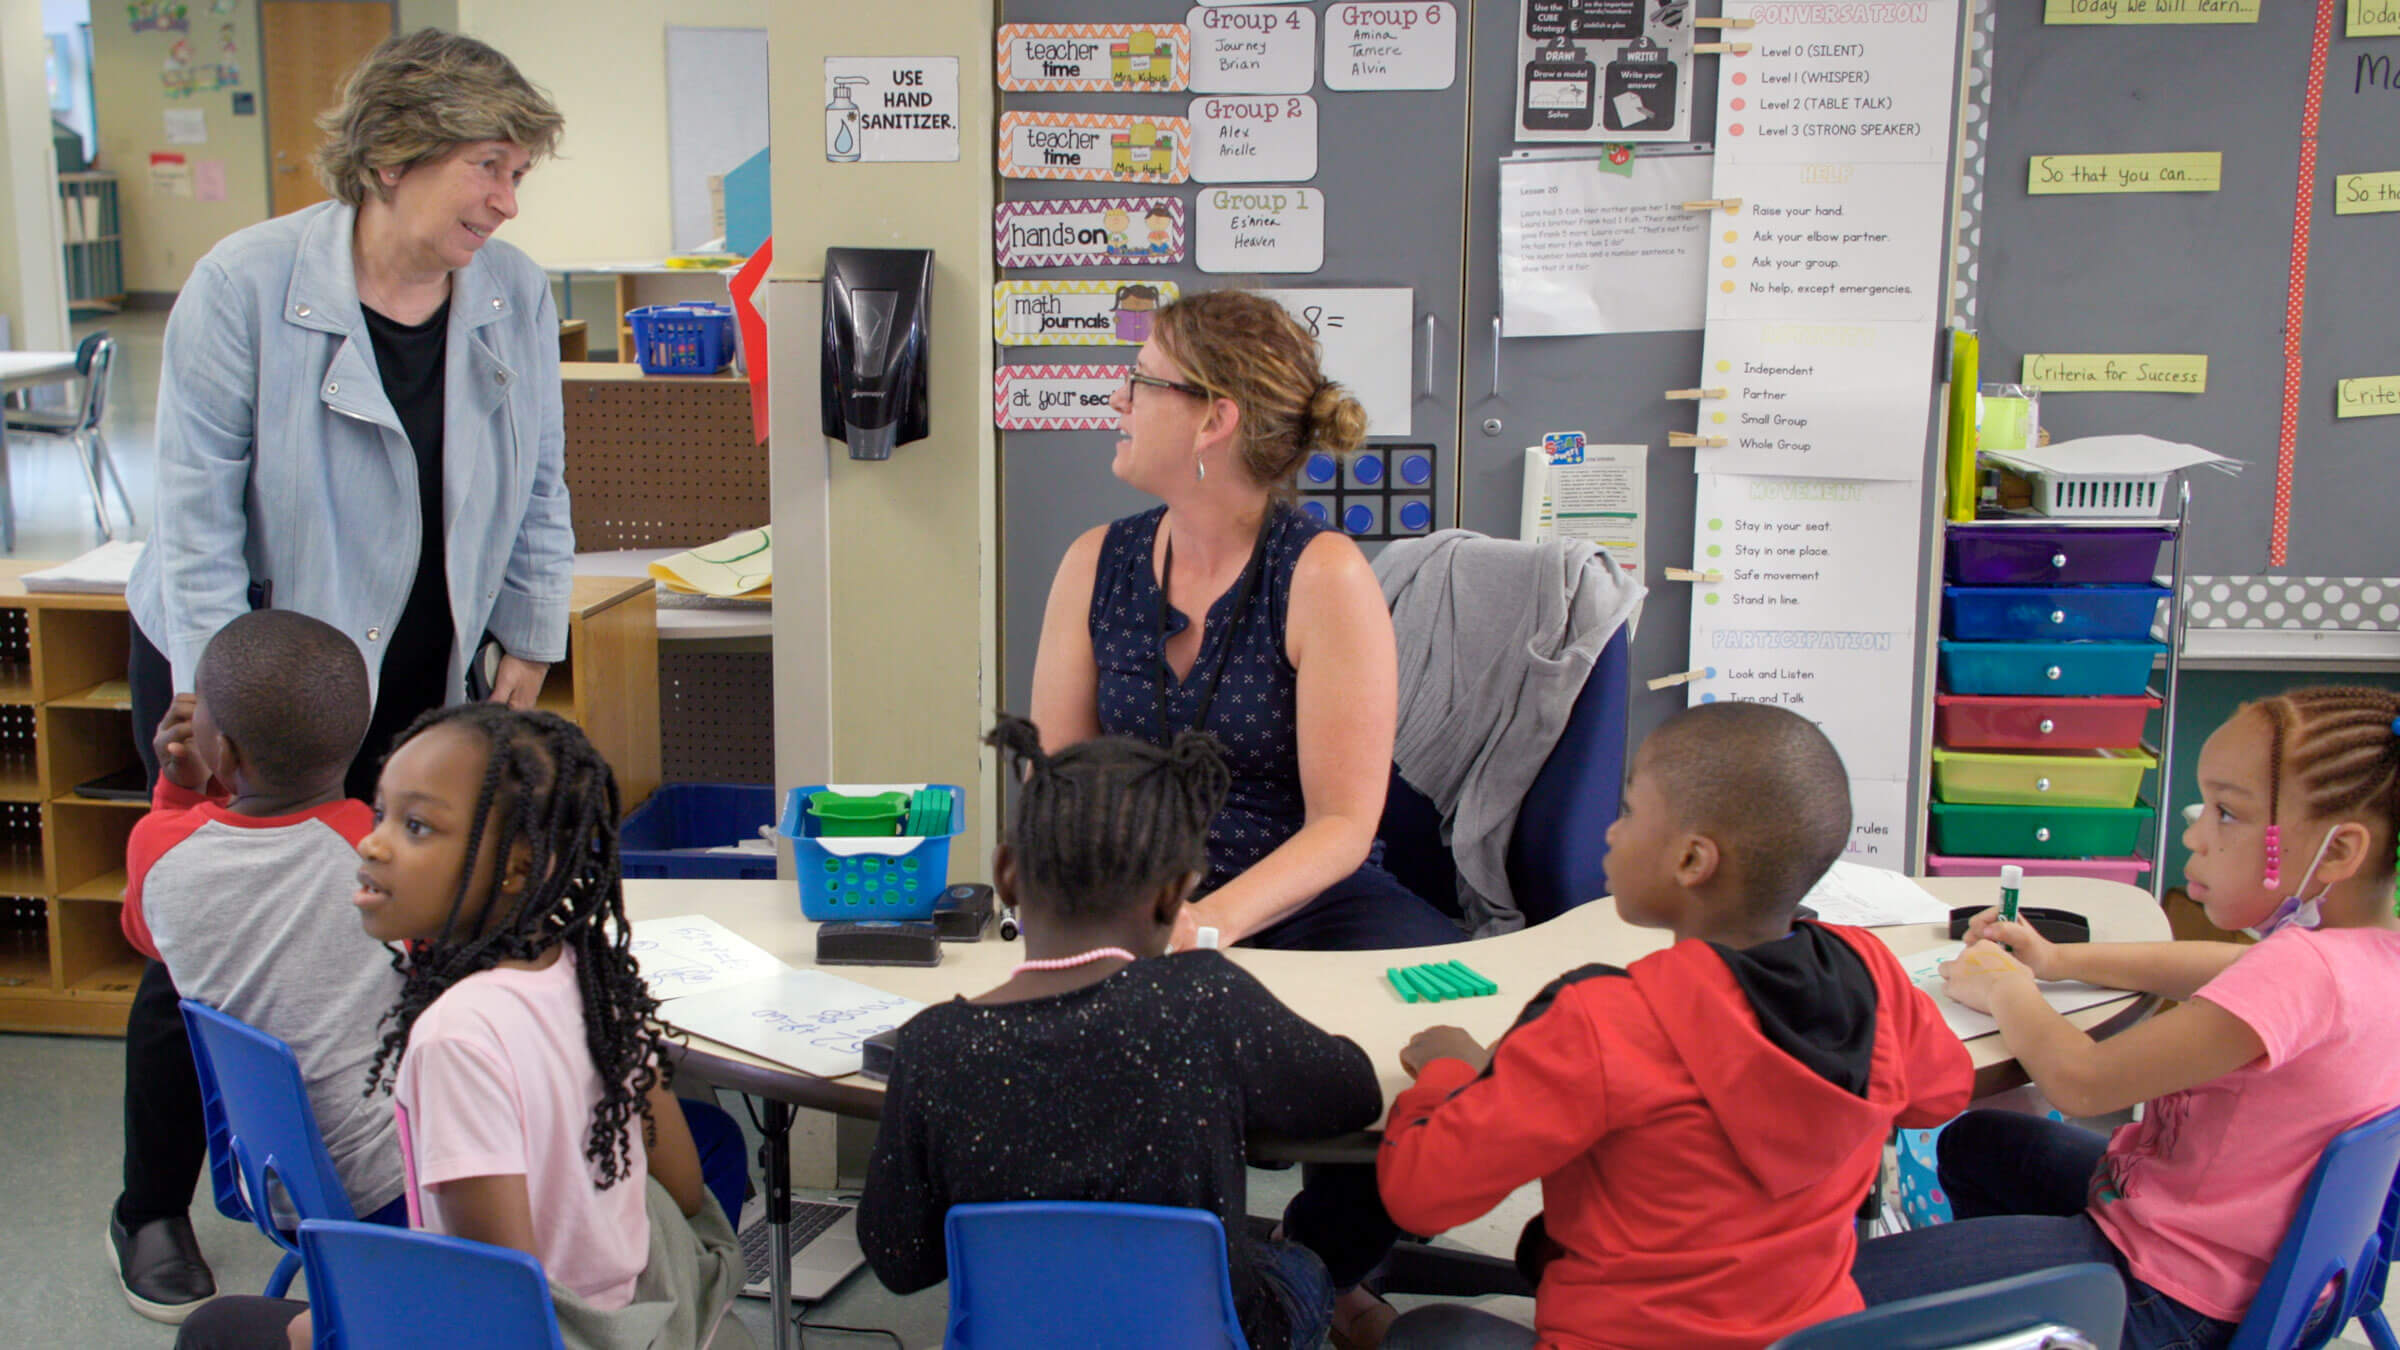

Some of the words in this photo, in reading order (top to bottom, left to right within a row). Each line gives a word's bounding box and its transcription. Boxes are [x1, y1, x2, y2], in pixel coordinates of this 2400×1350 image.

[1550, 3, 1563, 12] the
[1751, 3, 1929, 24] CONVERSATION
[2358, 0, 2400, 30] oda
[1203, 9, 1277, 34] Group
[1285, 9, 1300, 30] 4
[1342, 6, 1418, 30] Group
[1425, 4, 1441, 25] 6
[1537, 13, 1559, 22] CUBE
[1353, 30, 1398, 41] Amina
[1532, 24, 1566, 34] Strategy
[1215, 39, 1266, 54] Journey
[1556, 36, 1566, 48] 2
[1639, 36, 1648, 48] 3
[1026, 41, 1099, 61] teacher
[1761, 45, 1792, 57] Level
[1807, 43, 1864, 58] (SILENT)
[1042, 61, 1080, 78] time
[1219, 58, 1260, 72] Brian
[1351, 62, 1387, 76] Alvin
[892, 70, 924, 86] USE
[1533, 70, 1555, 79] Draw
[1563, 70, 1588, 79] model
[1620, 71, 1643, 79] Write
[1761, 72, 1792, 84] Level
[1801, 70, 1870, 85] (WHISPER)
[884, 92, 933, 108] HAND
[1760, 98, 1790, 110] Level
[1792, 98, 1800, 110] 2
[1804, 97, 1849, 111] (TABLE
[1854, 97, 1893, 111] TALK)
[1205, 99, 1280, 123] Group
[1287, 98, 1303, 118] 2
[1547, 111, 1569, 119] Solve
[861, 113, 957, 130] SANITIZER.
[1758, 124, 1788, 137] Level
[1791, 124, 1799, 136] 3
[1802, 123, 1857, 137] (STRONG
[1860, 122, 1921, 137] SPEAKER)
[1027, 129, 1100, 150] teacher
[1219, 125, 1250, 139] Alex
[1043, 149, 1081, 166] time
[1219, 142, 1257, 157] Arielle
[1801, 163, 1854, 185] HELP
[2041, 157, 2064, 183] So
[2071, 165, 2108, 182] that
[2119, 168, 2150, 187] you
[2346, 176, 2369, 202] So
[1213, 190, 1288, 215] Group
[1296, 190, 1309, 210] 1
[1752, 204, 1782, 217] Raise
[1785, 207, 1812, 223] your
[1815, 204, 1844, 217] hand.
[1012, 222, 1076, 248] hands
[1077, 228, 1109, 245] on
[1234, 233, 1276, 249] Heaven
[1753, 230, 1773, 242] Ask
[1777, 232, 1802, 249] your
[1807, 231, 1839, 243] elbow
[1842, 231, 1890, 249] partner.
[1752, 256, 1772, 268] Ask
[1776, 258, 1801, 275] your
[1805, 258, 1841, 276] group.
[1750, 282, 1766, 294] No
[1768, 282, 1794, 300] help,
[1797, 282, 1836, 301] except
[1839, 283, 1913, 301] emergencies.
[1015, 294, 1062, 316] math
[1039, 312, 1110, 334] journals
[1743, 361, 1814, 377] Independent
[2032, 354, 2096, 381] Criteria
[2105, 360, 2128, 382] for
[2137, 362, 2198, 383] Success
[1743, 388, 1787, 400] Partner
[2343, 378, 2400, 404] Crite
[1012, 388, 1032, 407] at
[1038, 390, 1077, 411] your
[1079, 390, 1116, 407] sea
[1741, 413, 1770, 425] Small
[1773, 415, 1808, 429] Group
[1739, 438, 1774, 450] Whole
[1777, 439, 1812, 453] Group
[1750, 481, 1864, 501] MOVEMENT
[1735, 519, 1760, 532] Stay
[1763, 520, 1773, 531] in
[1776, 521, 1801, 533] your
[1735, 544, 1761, 557] Stay
[1764, 545, 1773, 556] in
[1776, 546, 1796, 556] one
[1734, 569, 1760, 581] Safe
[1763, 570, 1820, 581] movement
[1733, 593, 1765, 605] Stand
[1767, 594, 1777, 605] in
[1711, 629, 1892, 651] PARTICIPATION
[1728, 668, 1754, 680] Look
[1758, 669, 1777, 680] and
[1780, 668, 1815, 680] Listen
[1730, 693, 1756, 703] Turn
[1758, 693, 1778, 704] and
[1782, 693, 1805, 704] Talk
[1856, 822, 1889, 835] rules
[1867, 843, 1878, 854] in
